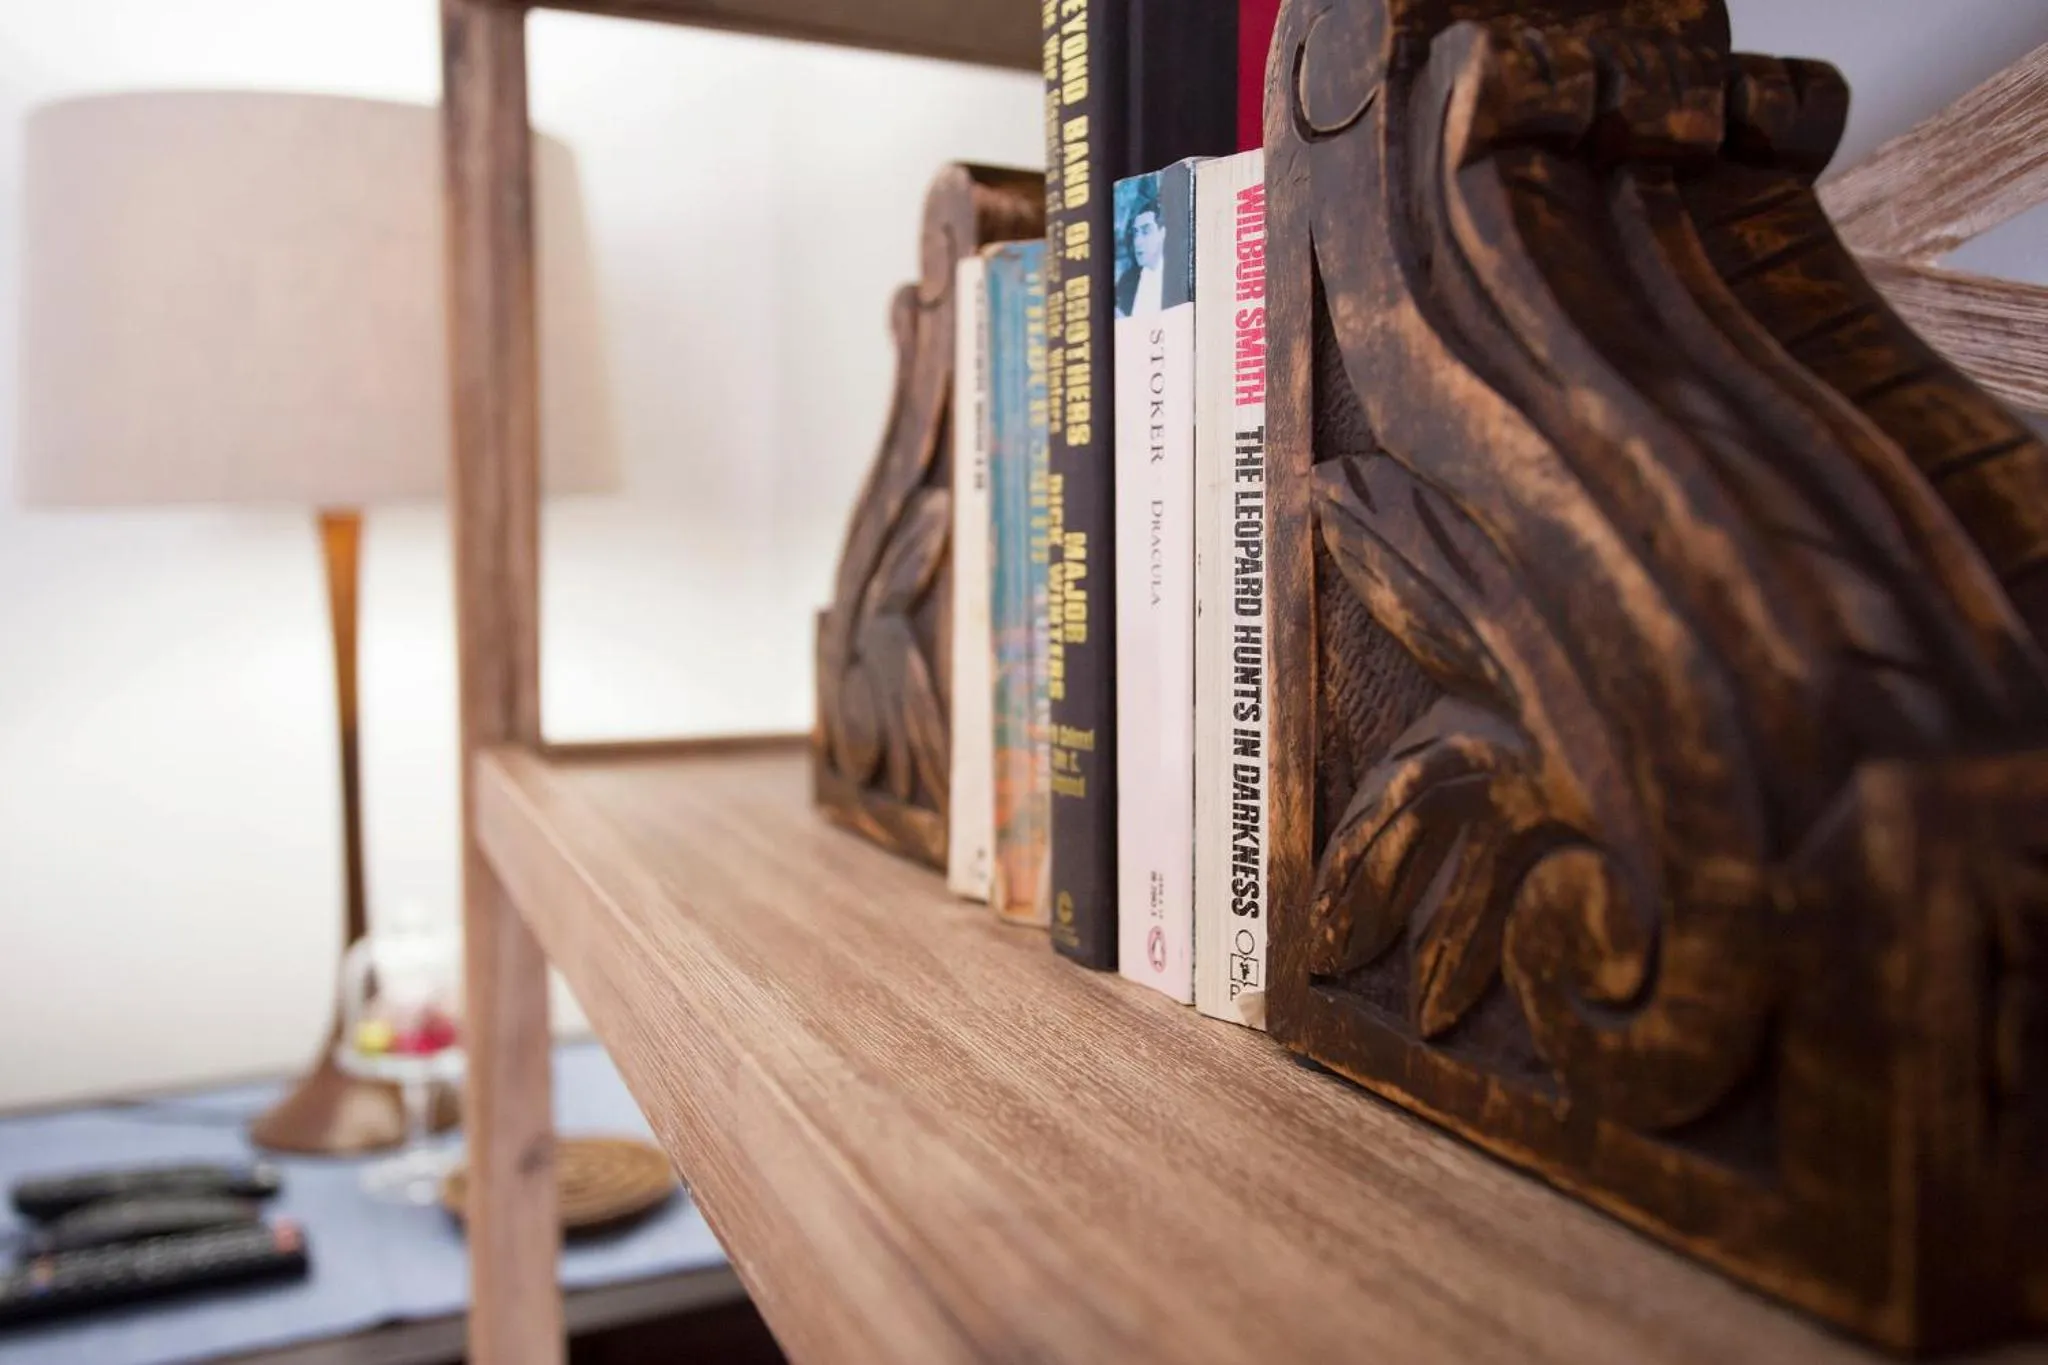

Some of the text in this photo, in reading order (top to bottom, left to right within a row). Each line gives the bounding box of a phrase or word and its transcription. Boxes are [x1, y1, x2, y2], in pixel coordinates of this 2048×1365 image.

[1061, 0, 1091, 447] EYOND BAND OF BROTHERS
[1149, 329, 1165, 464] STOKER
[1063, 532, 1087, 644] MAJOR
[1231, 184, 1267, 919] WILBUR SMITH THE LEOPARD HUNTS IN DARKNESS
